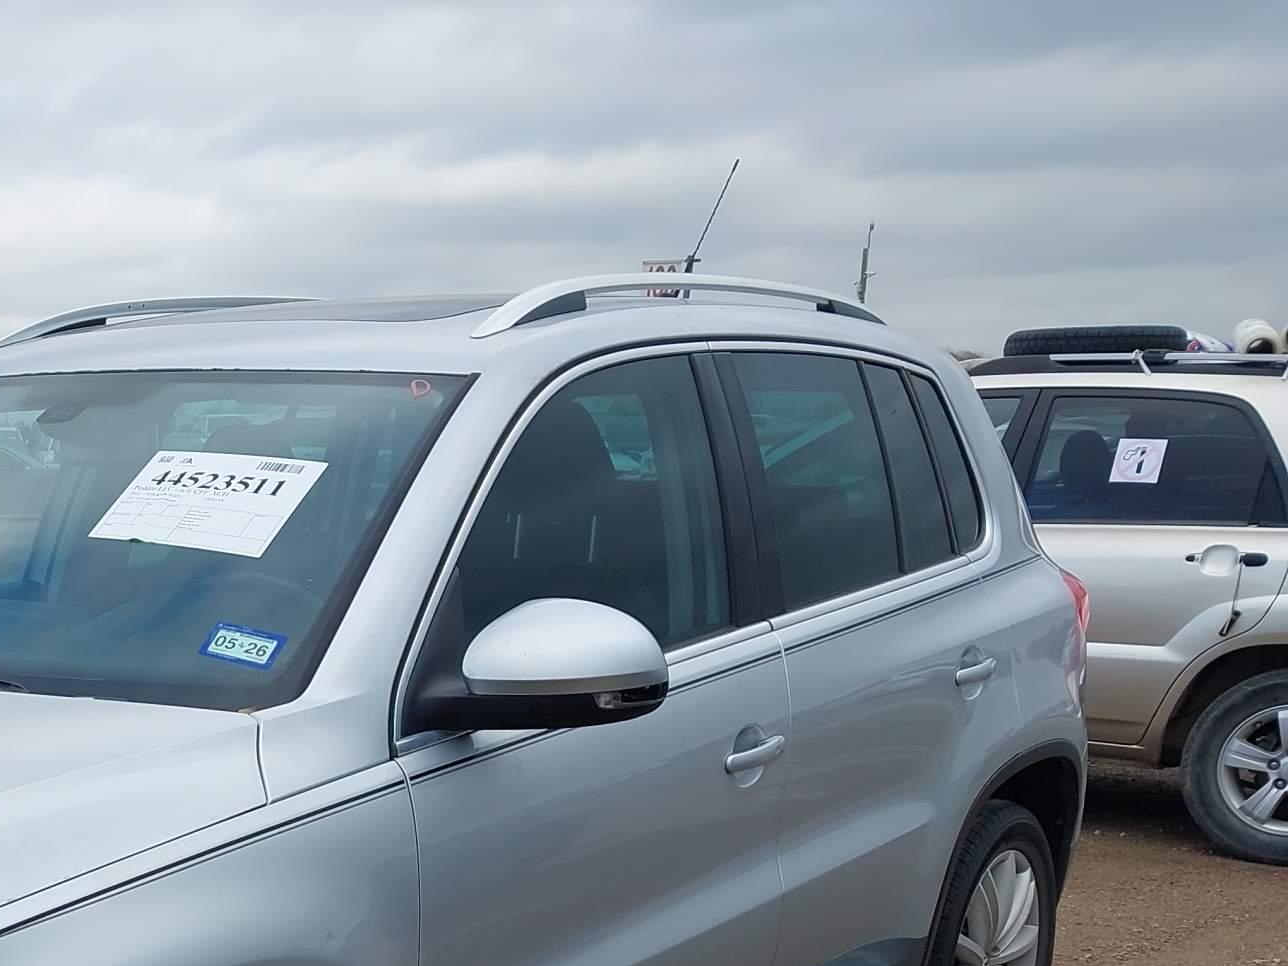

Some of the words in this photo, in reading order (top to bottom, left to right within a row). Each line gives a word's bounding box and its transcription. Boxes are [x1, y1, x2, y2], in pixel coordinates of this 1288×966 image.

[151, 470, 286, 496] 44523511
[214, 635, 238, 650] 05
[244, 642, 269, 657] 26
